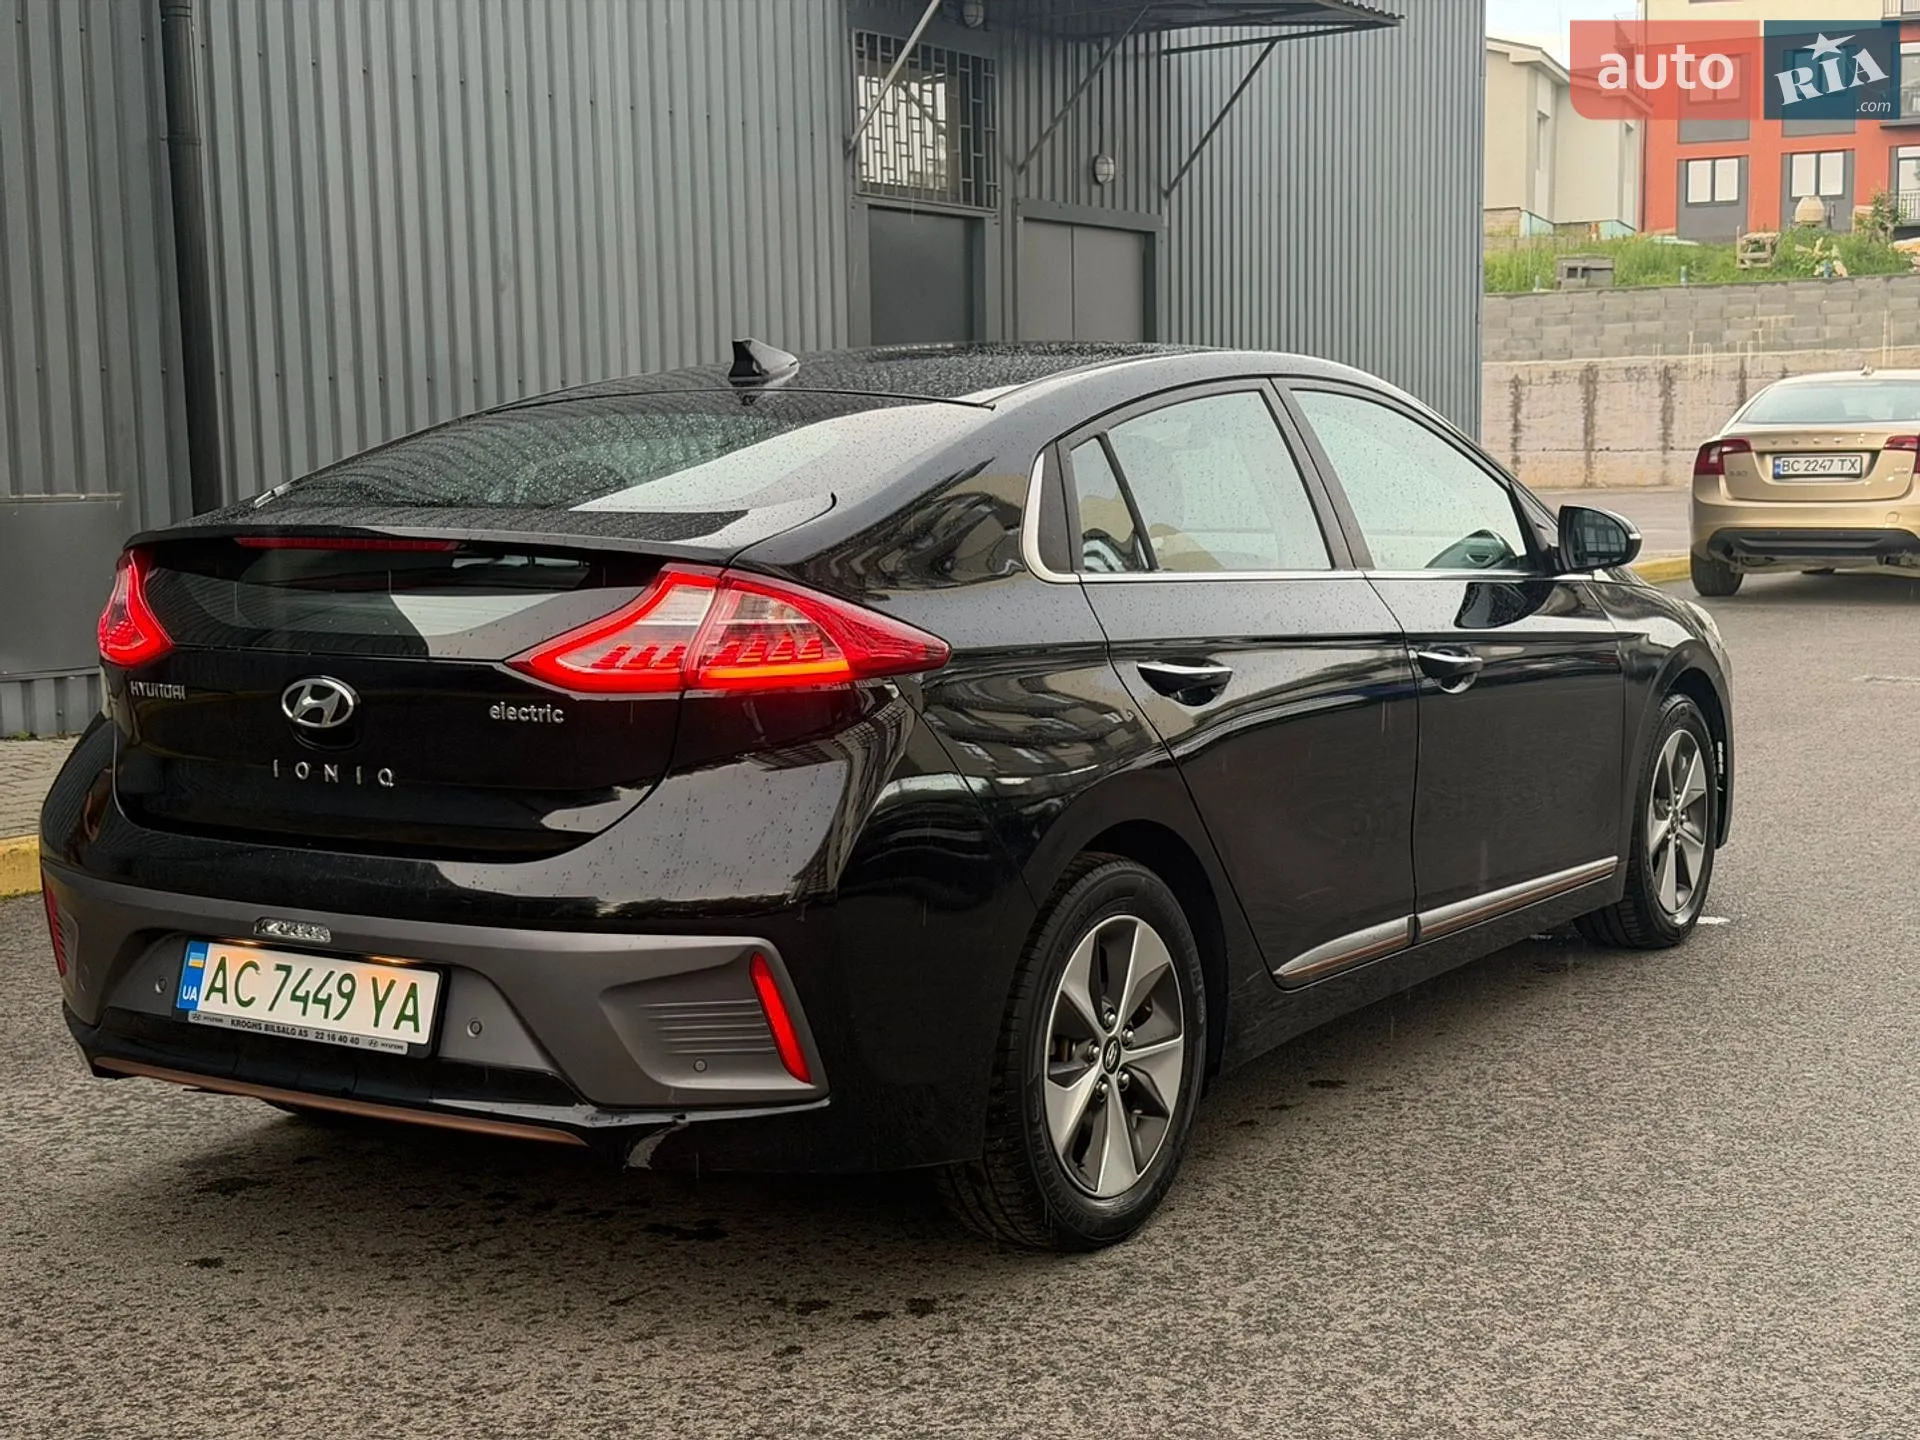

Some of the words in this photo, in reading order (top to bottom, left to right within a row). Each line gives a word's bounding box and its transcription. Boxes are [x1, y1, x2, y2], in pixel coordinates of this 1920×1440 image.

[1782, 460, 1800, 472] BC
[1804, 459, 1834, 472] 2247
[1838, 458, 1858, 471] TX
[130, 681, 186, 701] HYUNDAI
[489, 701, 565, 724] electric
[272, 757, 395, 788] IONIQ
[182, 985, 198, 1001] UA
[204, 955, 261, 1008] AC
[268, 963, 357, 1021] 7449
[371, 976, 420, 1033] YA
